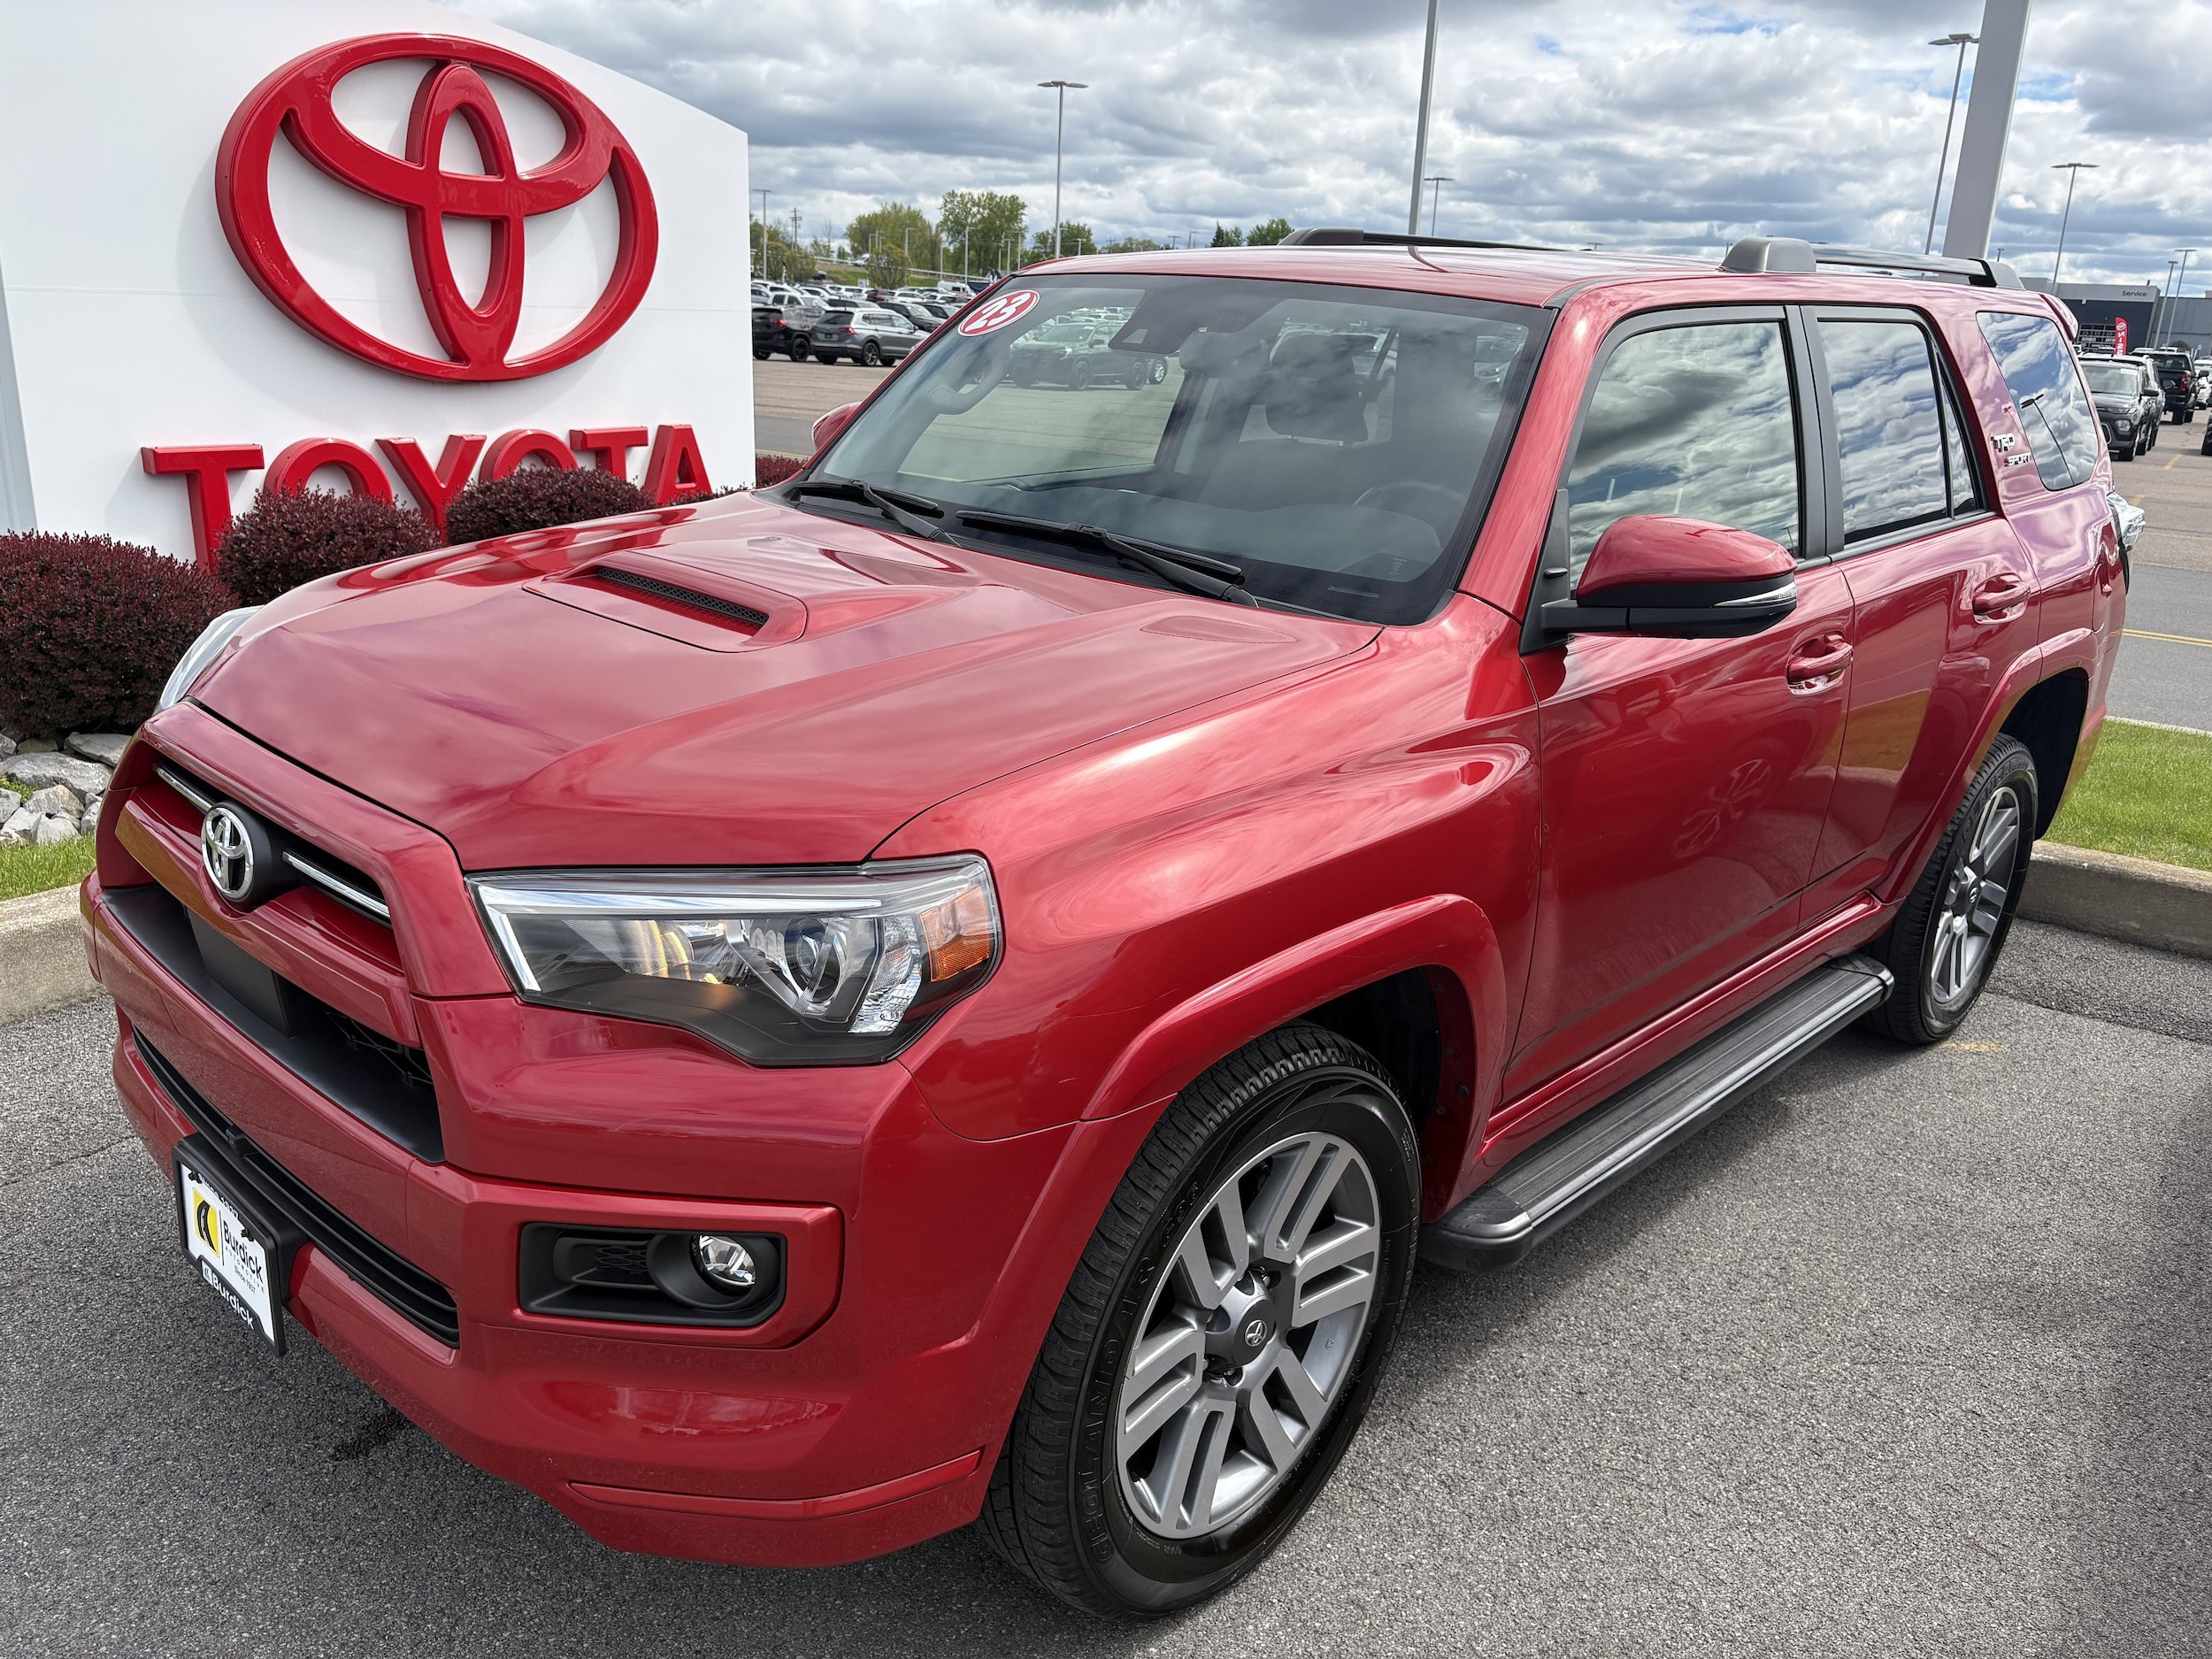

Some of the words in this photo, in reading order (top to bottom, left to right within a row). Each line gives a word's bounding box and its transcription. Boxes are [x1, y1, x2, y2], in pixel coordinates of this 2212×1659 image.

[964, 292, 1031, 333] 23
[1991, 433, 2015, 453] TRD
[2005, 452, 2032, 466] SPORT
[223, 1219, 264, 1284] Burdick
[212, 1272, 255, 1331] Burdick
